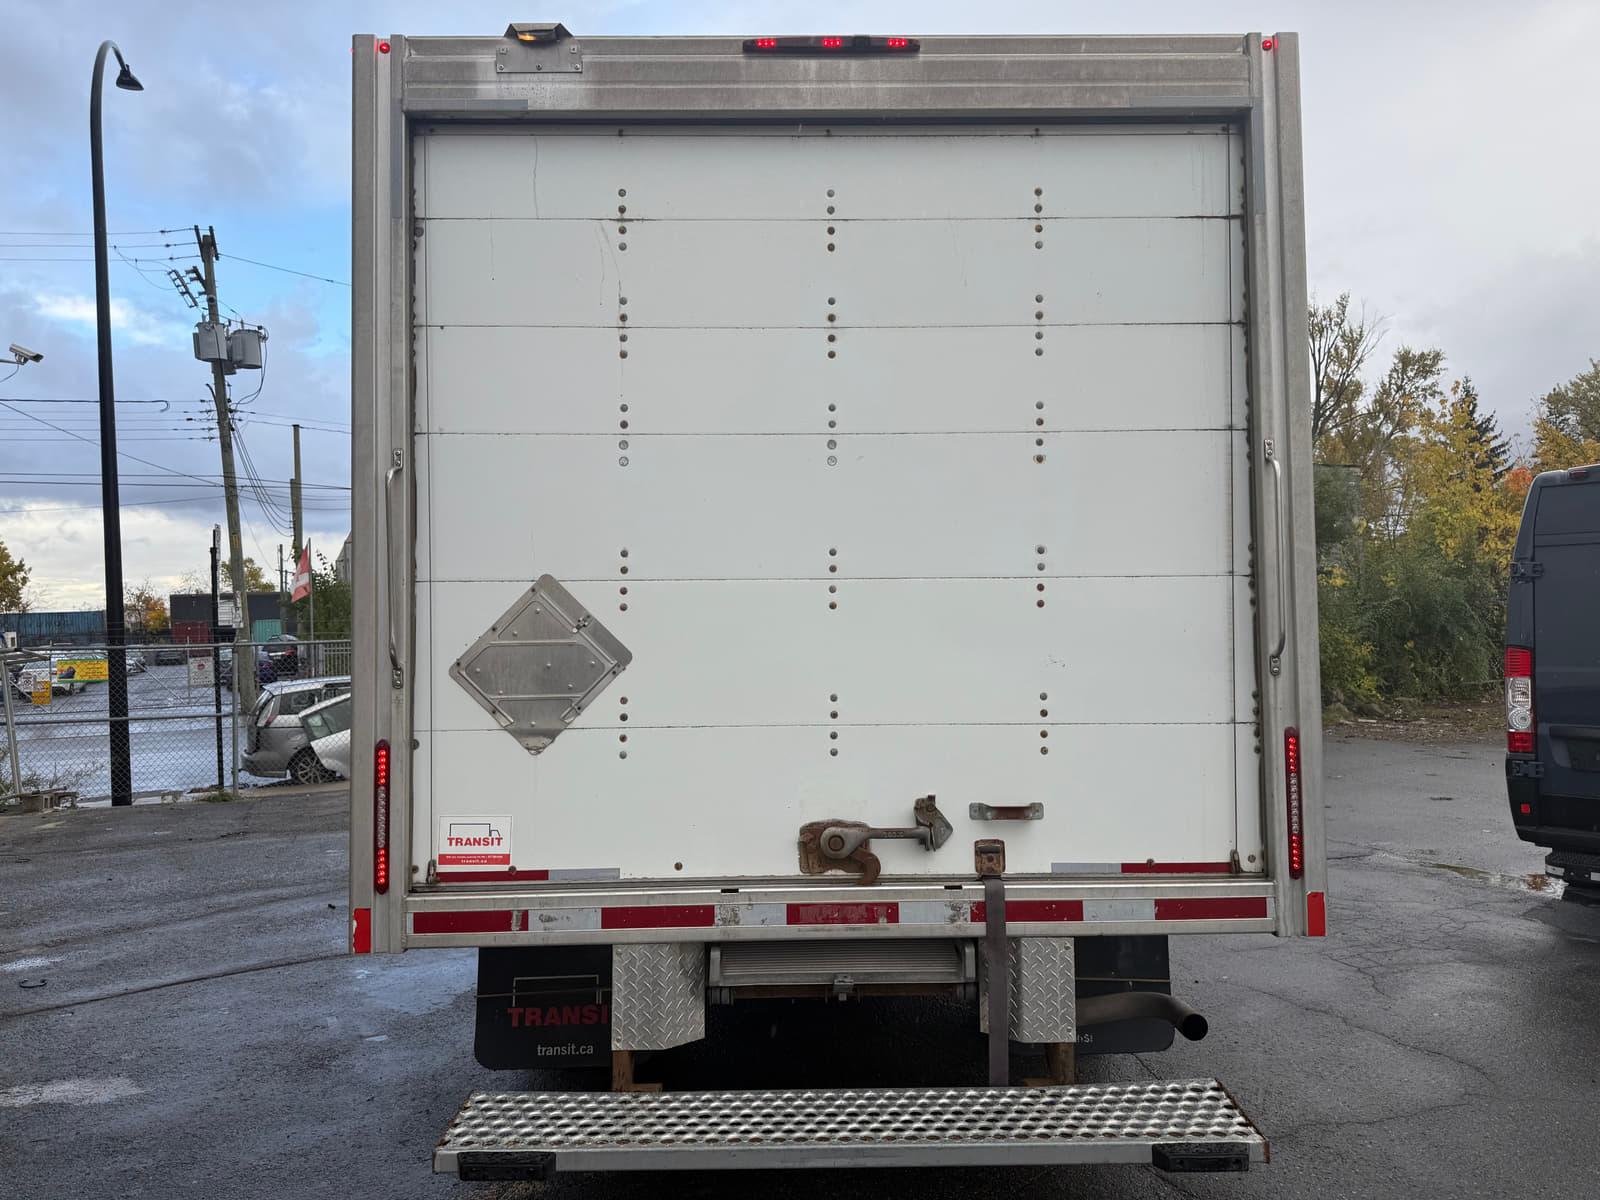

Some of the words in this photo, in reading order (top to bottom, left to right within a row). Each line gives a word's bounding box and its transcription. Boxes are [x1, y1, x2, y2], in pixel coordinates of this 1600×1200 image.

[447, 837, 504, 847] TRANSIT
[507, 1004, 609, 1029] TRANSI
[537, 1042, 594, 1056] transit.ca
